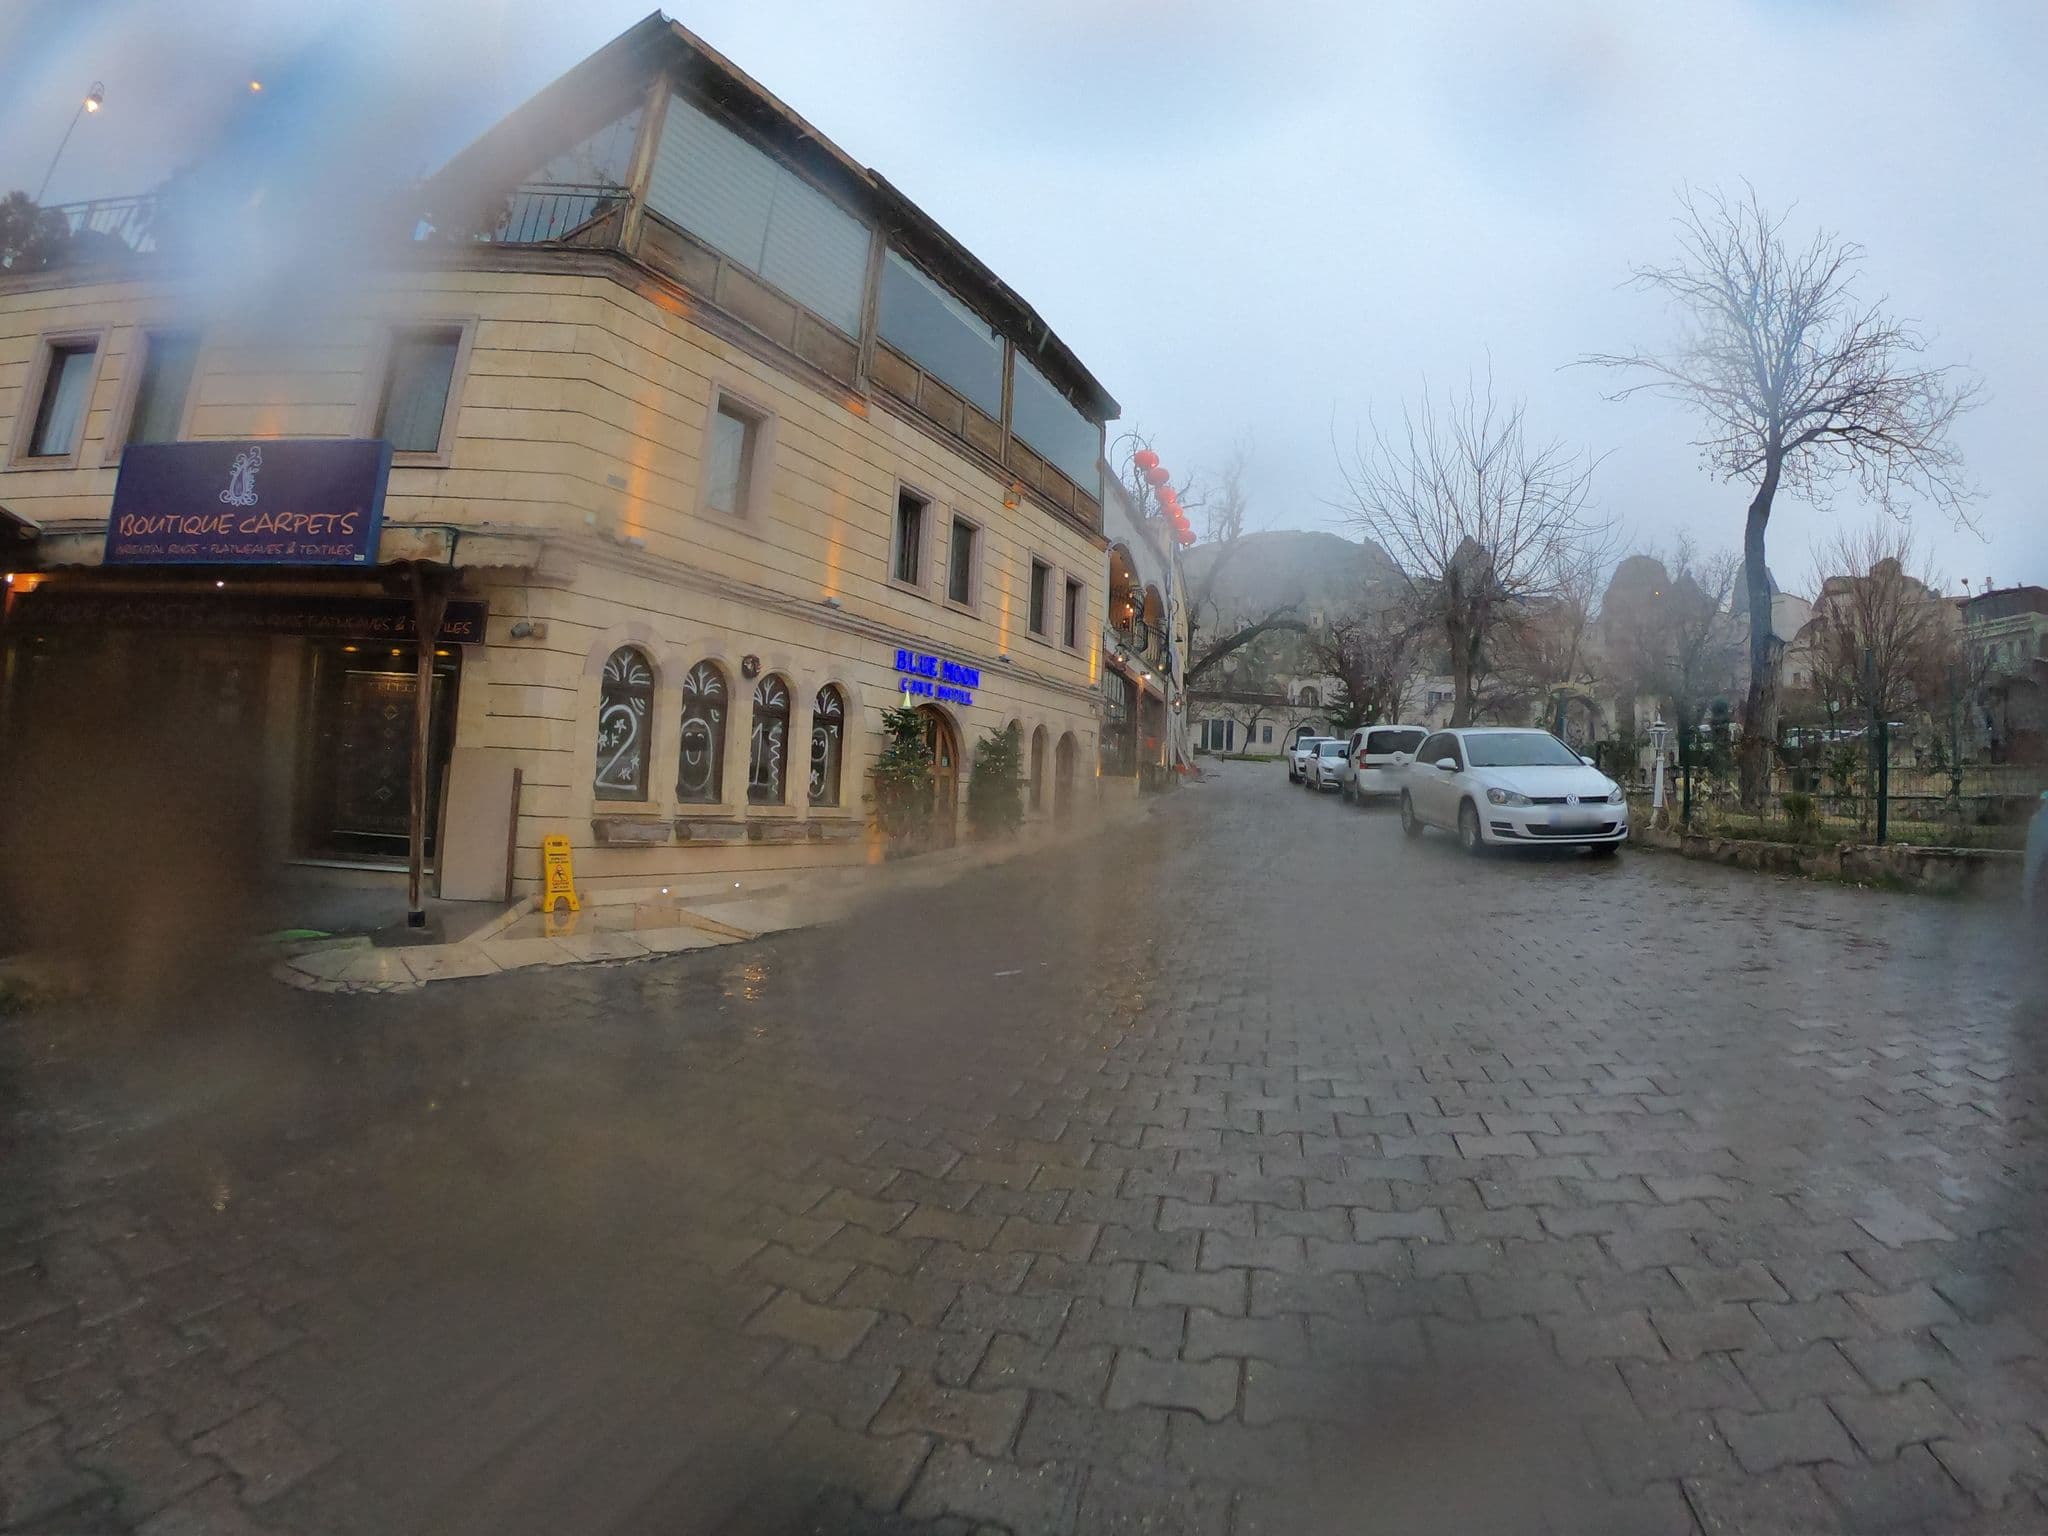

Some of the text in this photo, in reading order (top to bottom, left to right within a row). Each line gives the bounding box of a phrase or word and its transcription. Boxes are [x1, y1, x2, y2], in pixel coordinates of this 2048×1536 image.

[119, 511, 360, 537] BOUTIQUE CARPETS
[168, 543, 198, 555] RUGS
[299, 543, 355, 556] TEXTILES
[896, 647, 981, 688] BLUE MOON
[596, 703, 638, 791] 2
